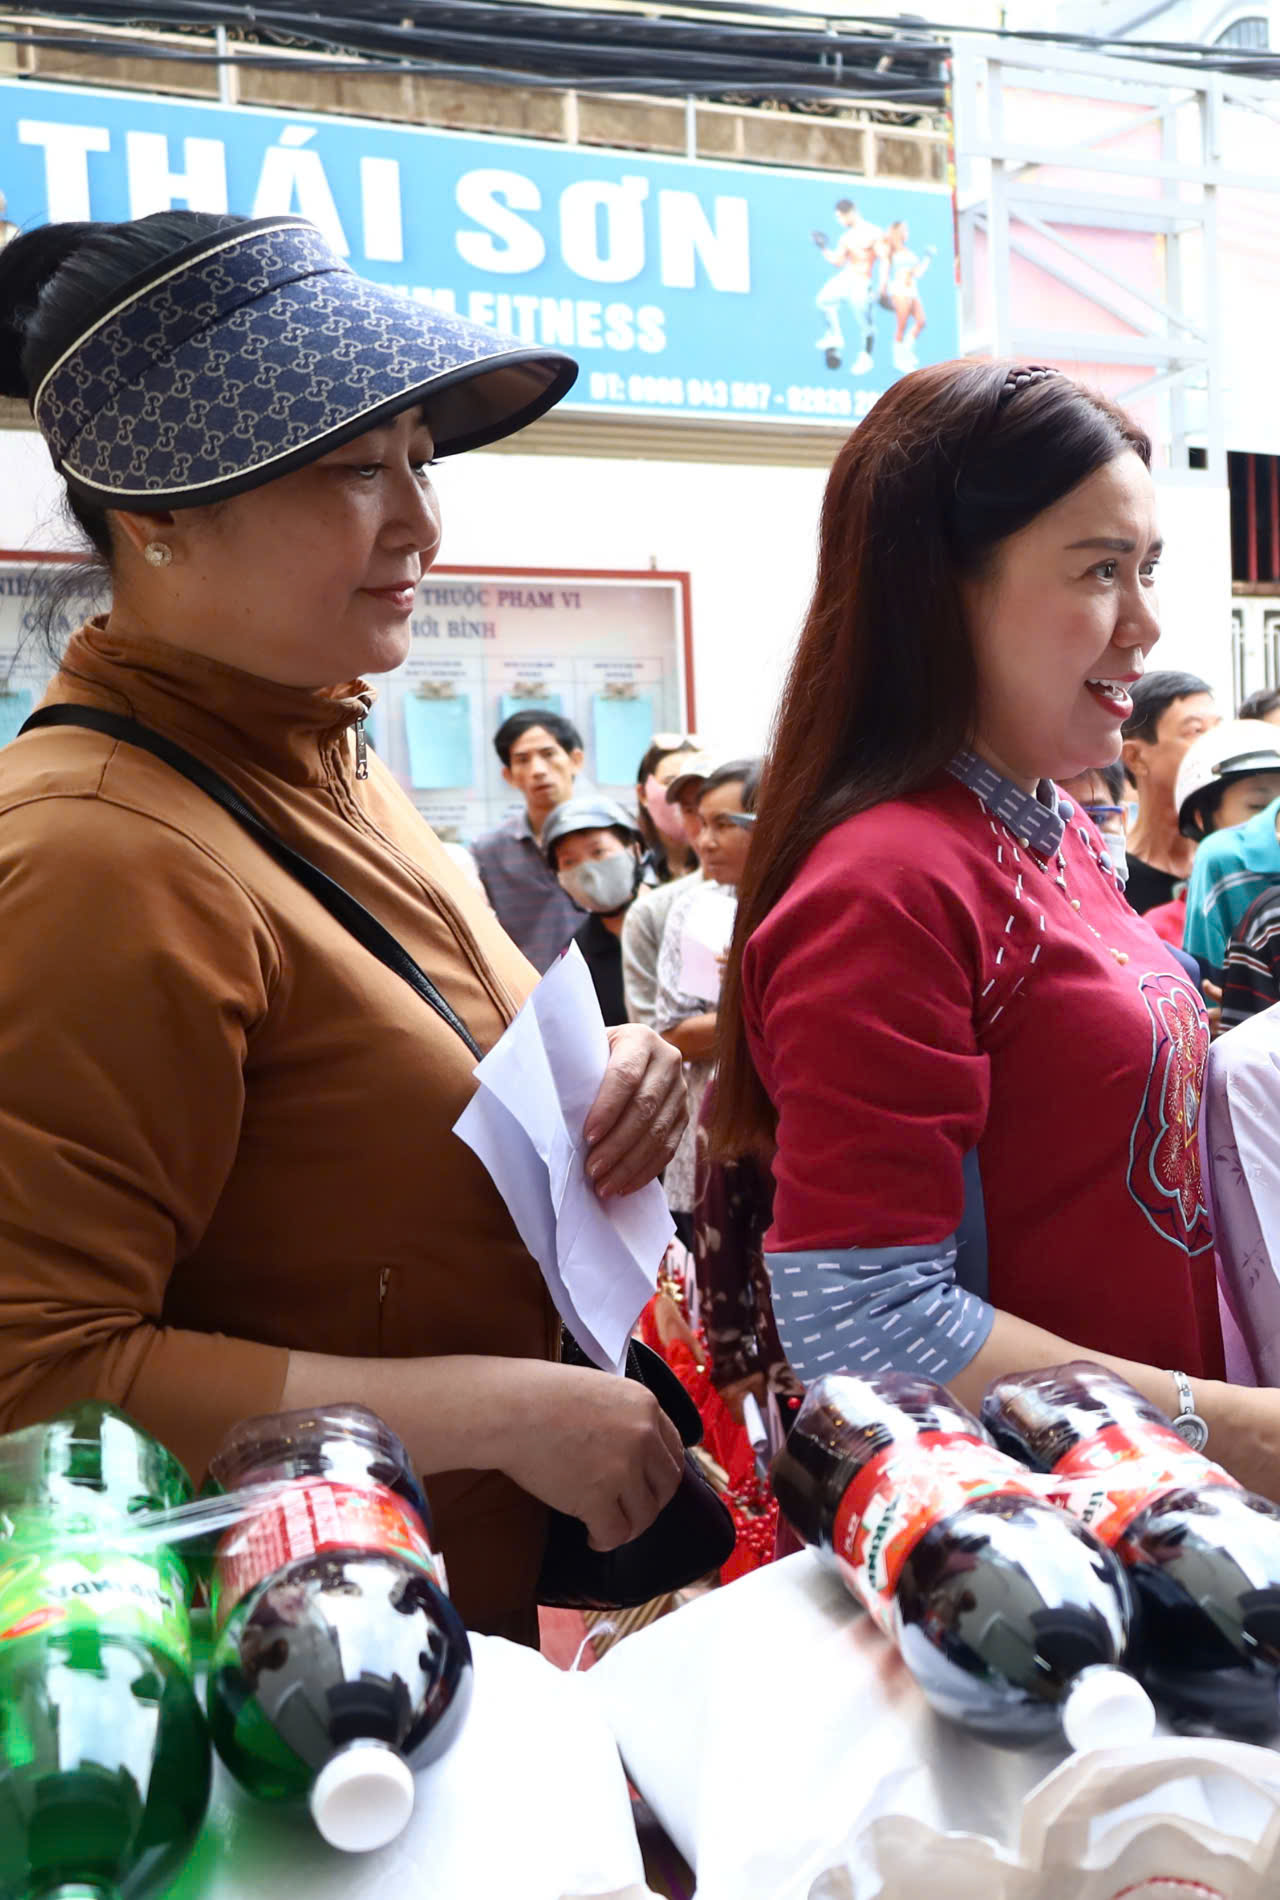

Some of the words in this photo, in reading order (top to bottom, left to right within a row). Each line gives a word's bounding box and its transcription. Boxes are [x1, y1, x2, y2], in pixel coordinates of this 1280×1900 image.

[18, 119, 403, 262] THÁI
[455, 168, 750, 293] SƠN
[469, 291, 667, 353] FITNESS
[497, 590, 554, 612] PHẠM
[561, 591, 581, 609] VI
